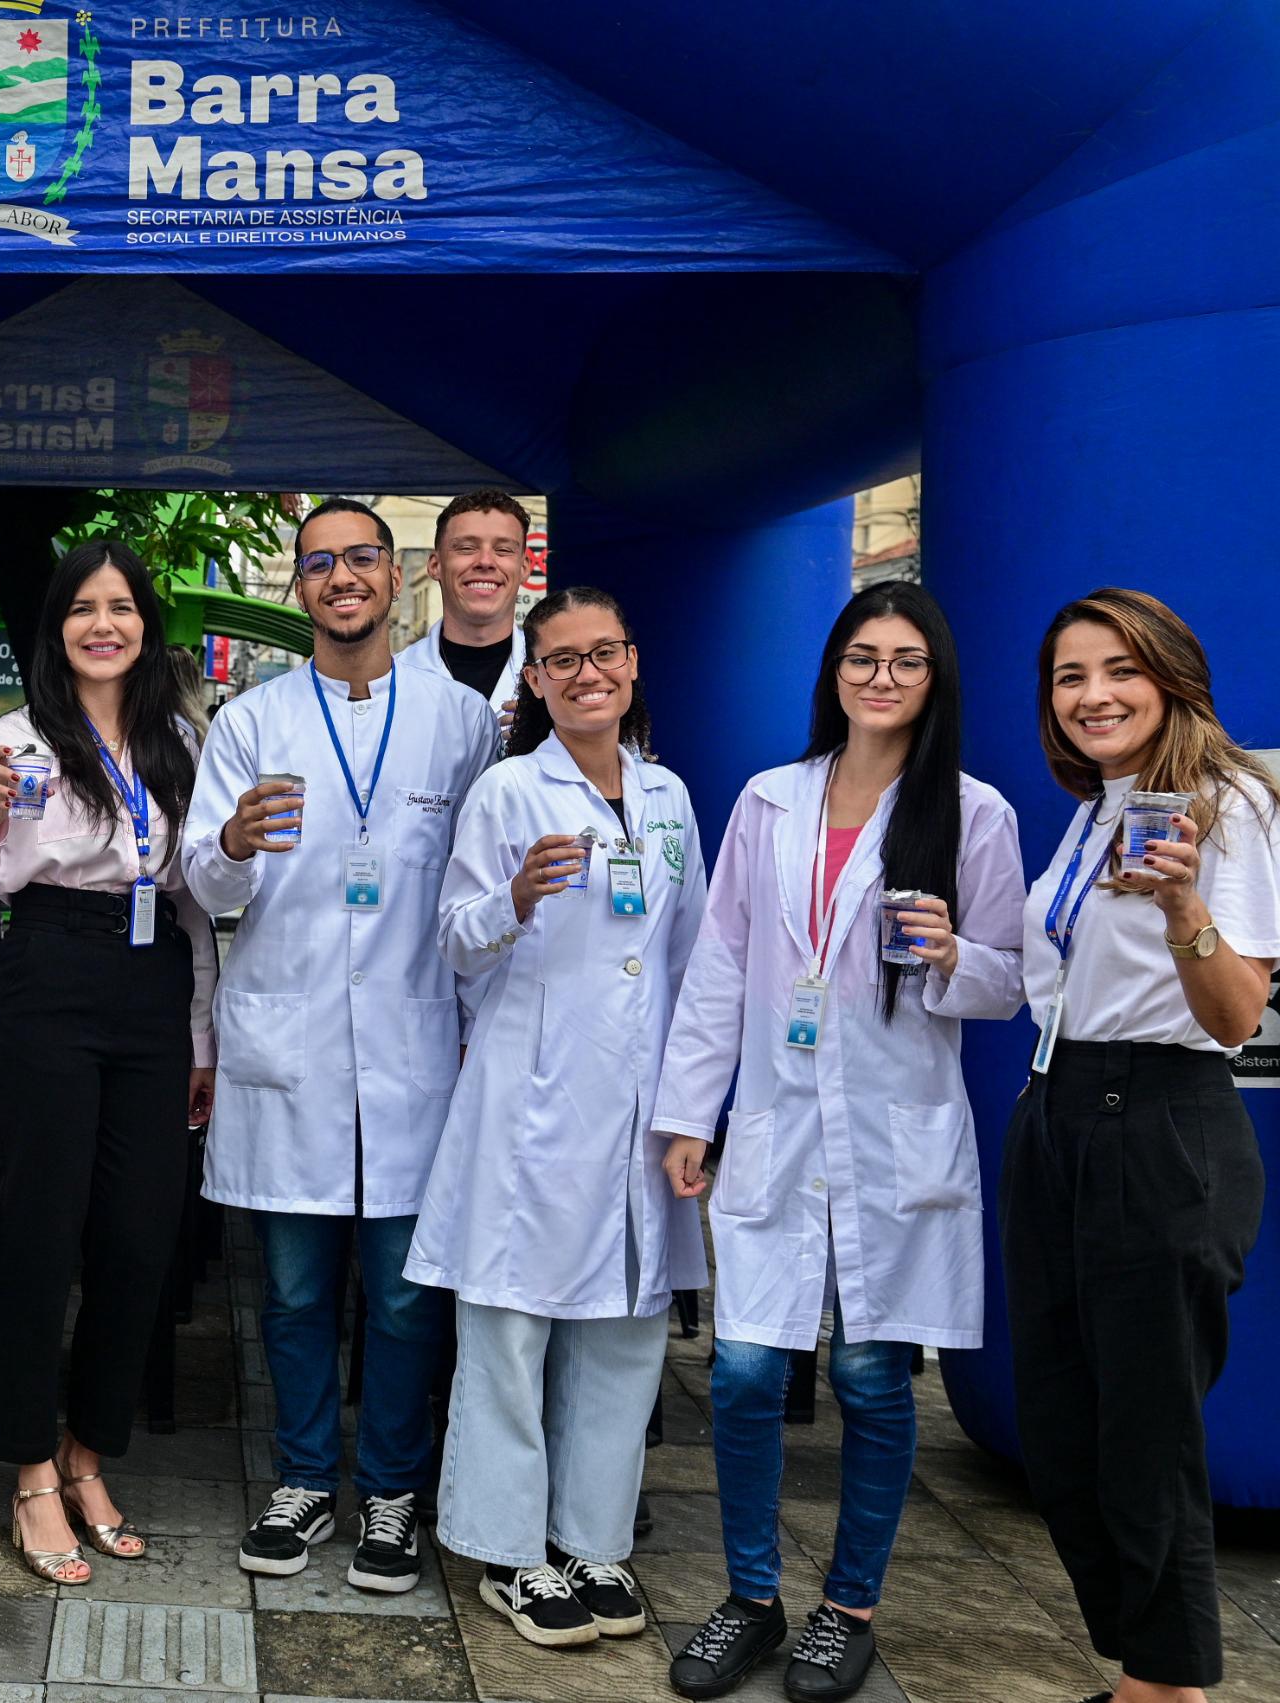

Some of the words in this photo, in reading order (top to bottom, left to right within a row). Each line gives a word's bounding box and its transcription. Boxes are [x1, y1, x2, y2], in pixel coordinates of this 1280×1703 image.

[131, 17, 342, 38] PREFEITURA
[130, 60, 400, 125] Barra
[129, 136, 428, 201] Mansa
[127, 210, 245, 225] SECRETARIA
[250, 210, 274, 225] DE
[279, 207, 403, 225] ASSISTÊNCIA
[126, 232, 194, 244] SOCIAL
[199, 232, 211, 244] E
[217, 231, 304, 243] DIREITOS
[310, 230, 407, 242] HUMANOS
